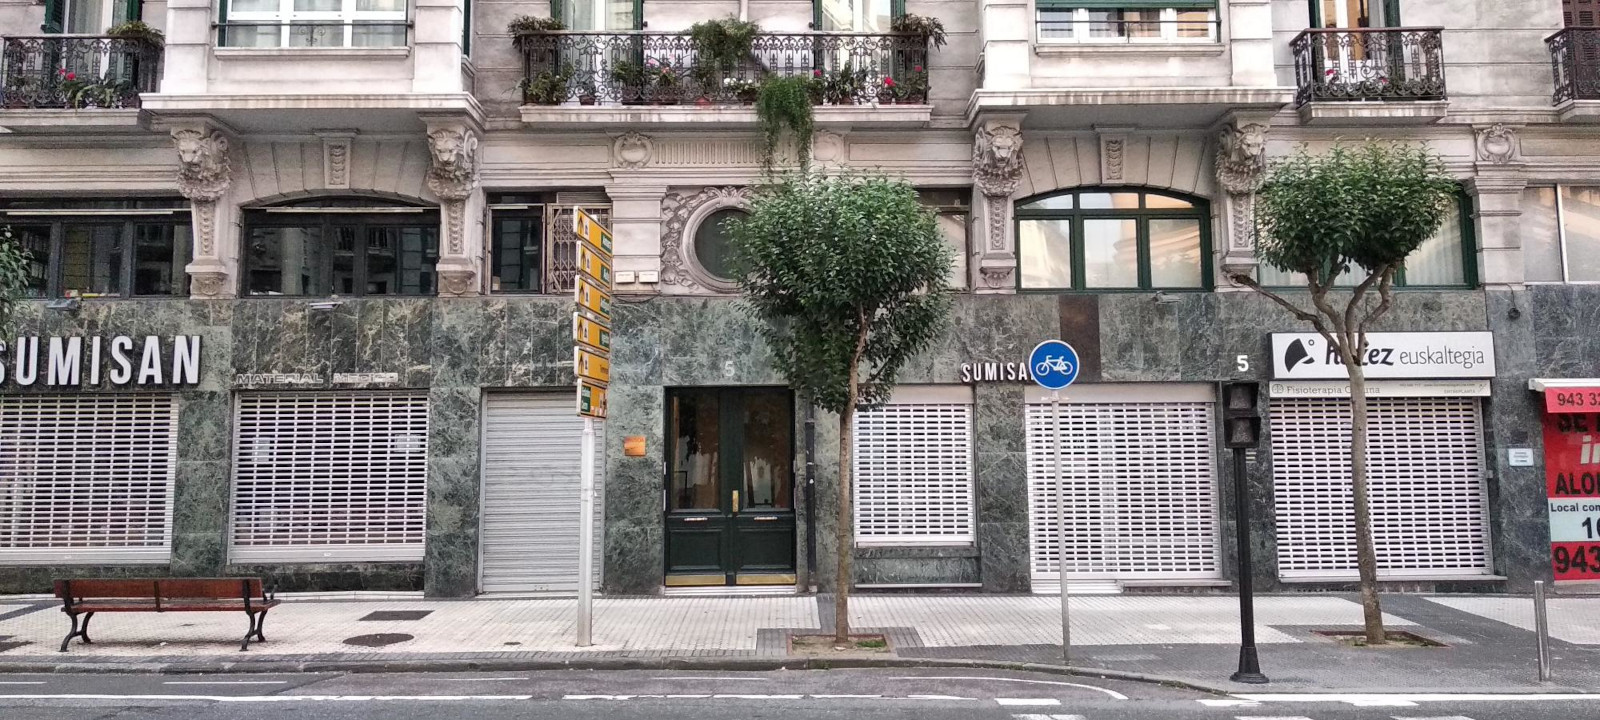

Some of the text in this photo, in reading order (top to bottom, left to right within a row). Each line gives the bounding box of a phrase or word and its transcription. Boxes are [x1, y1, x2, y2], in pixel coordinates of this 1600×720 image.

[0, 335, 200, 386] UMISAN
[1237, 355, 1249, 371] 5
[1400, 345, 1484, 369] euskaltegia
[725, 361, 735, 376] 5
[962, 362, 1035, 382] SUMISA
[236, 373, 324, 384] MATERIAL
[1286, 386, 1342, 395] Fisioterapia
[1557, 392, 1600, 406] 943 3
[1555, 472, 1600, 494] ALO
[1550, 503, 1579, 512] Local
[1582, 517, 1600, 538] 1
[1554, 546, 1600, 573] 943
